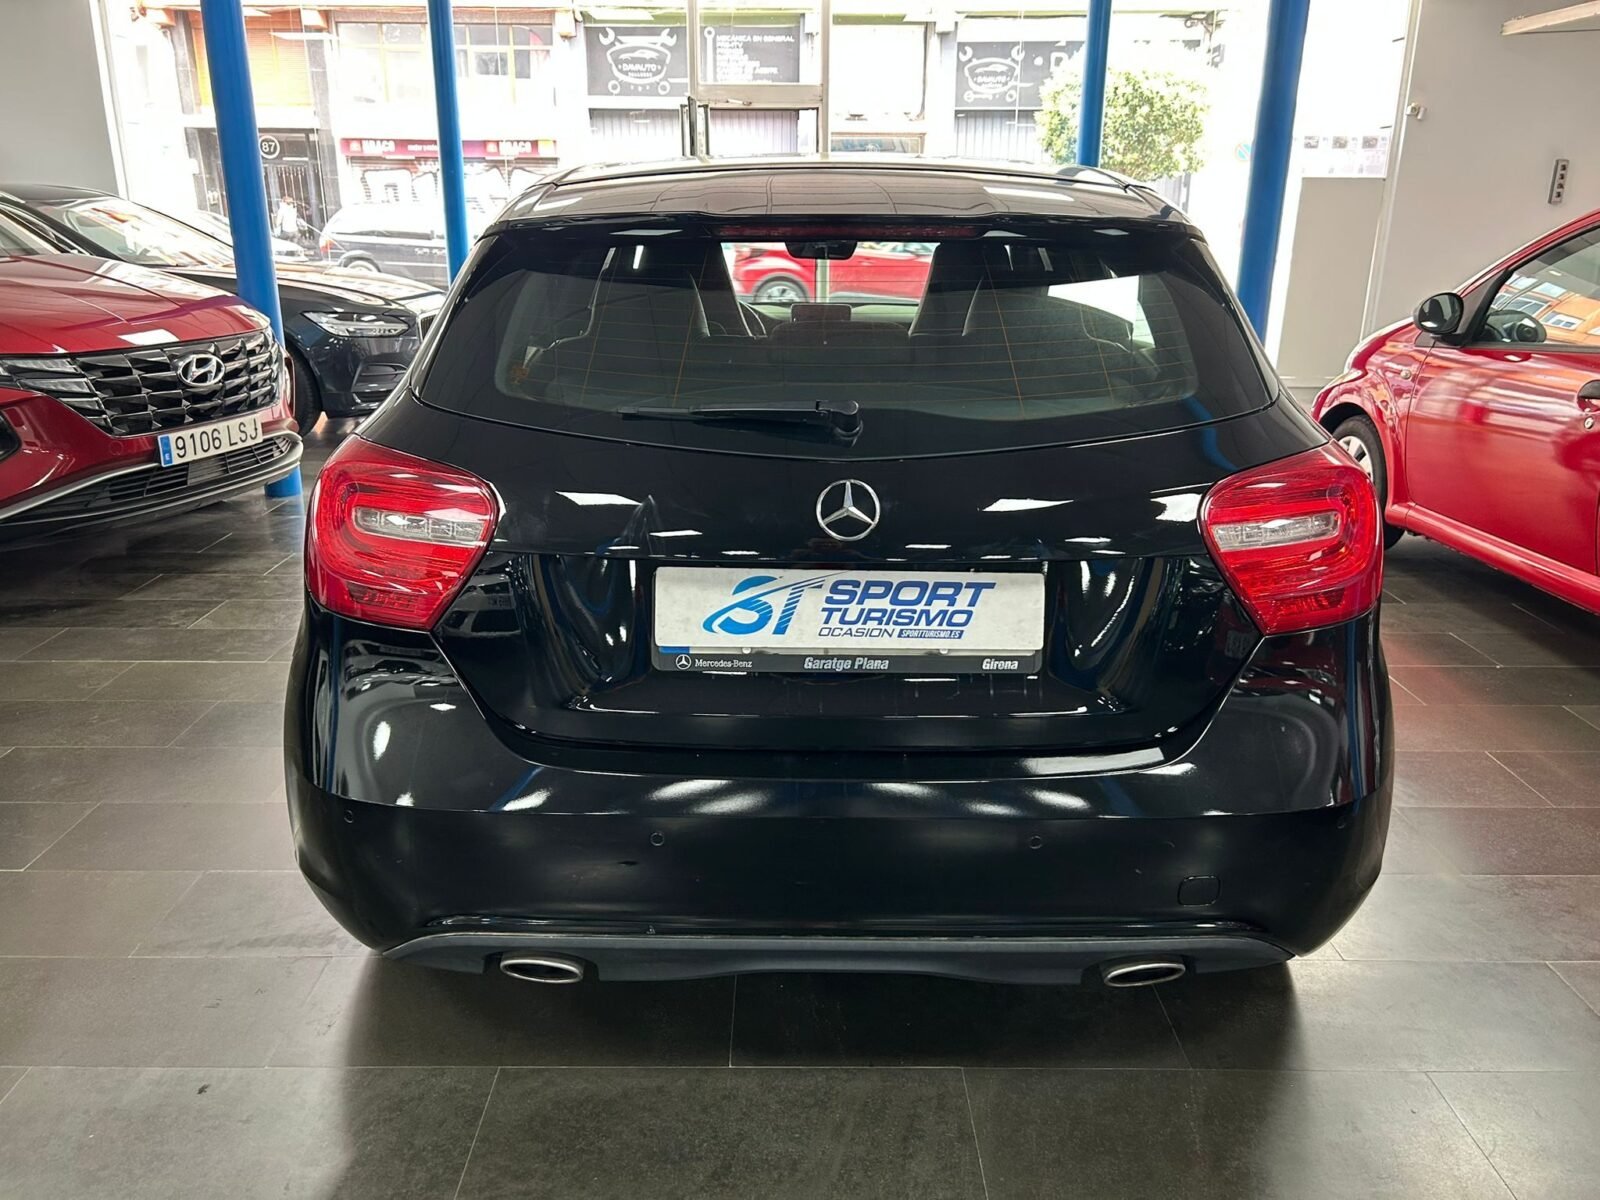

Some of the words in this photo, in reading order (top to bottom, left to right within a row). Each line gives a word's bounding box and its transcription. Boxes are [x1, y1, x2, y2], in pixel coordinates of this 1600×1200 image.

[261, 141, 276, 152] 87
[175, 428, 222, 459] 9106
[226, 417, 259, 447] LSJ
[824, 579, 997, 608] SPORT
[820, 607, 975, 628] TURISMO
[818, 627, 895, 639] OCASION
[899, 629, 962, 640] SPORTTURISMO.ES
[694, 658, 753, 668] Mercedes-Benz
[803, 657, 851, 671] Garatge
[853, 657, 889, 670] Plana
[982, 658, 1018, 671] Girona
